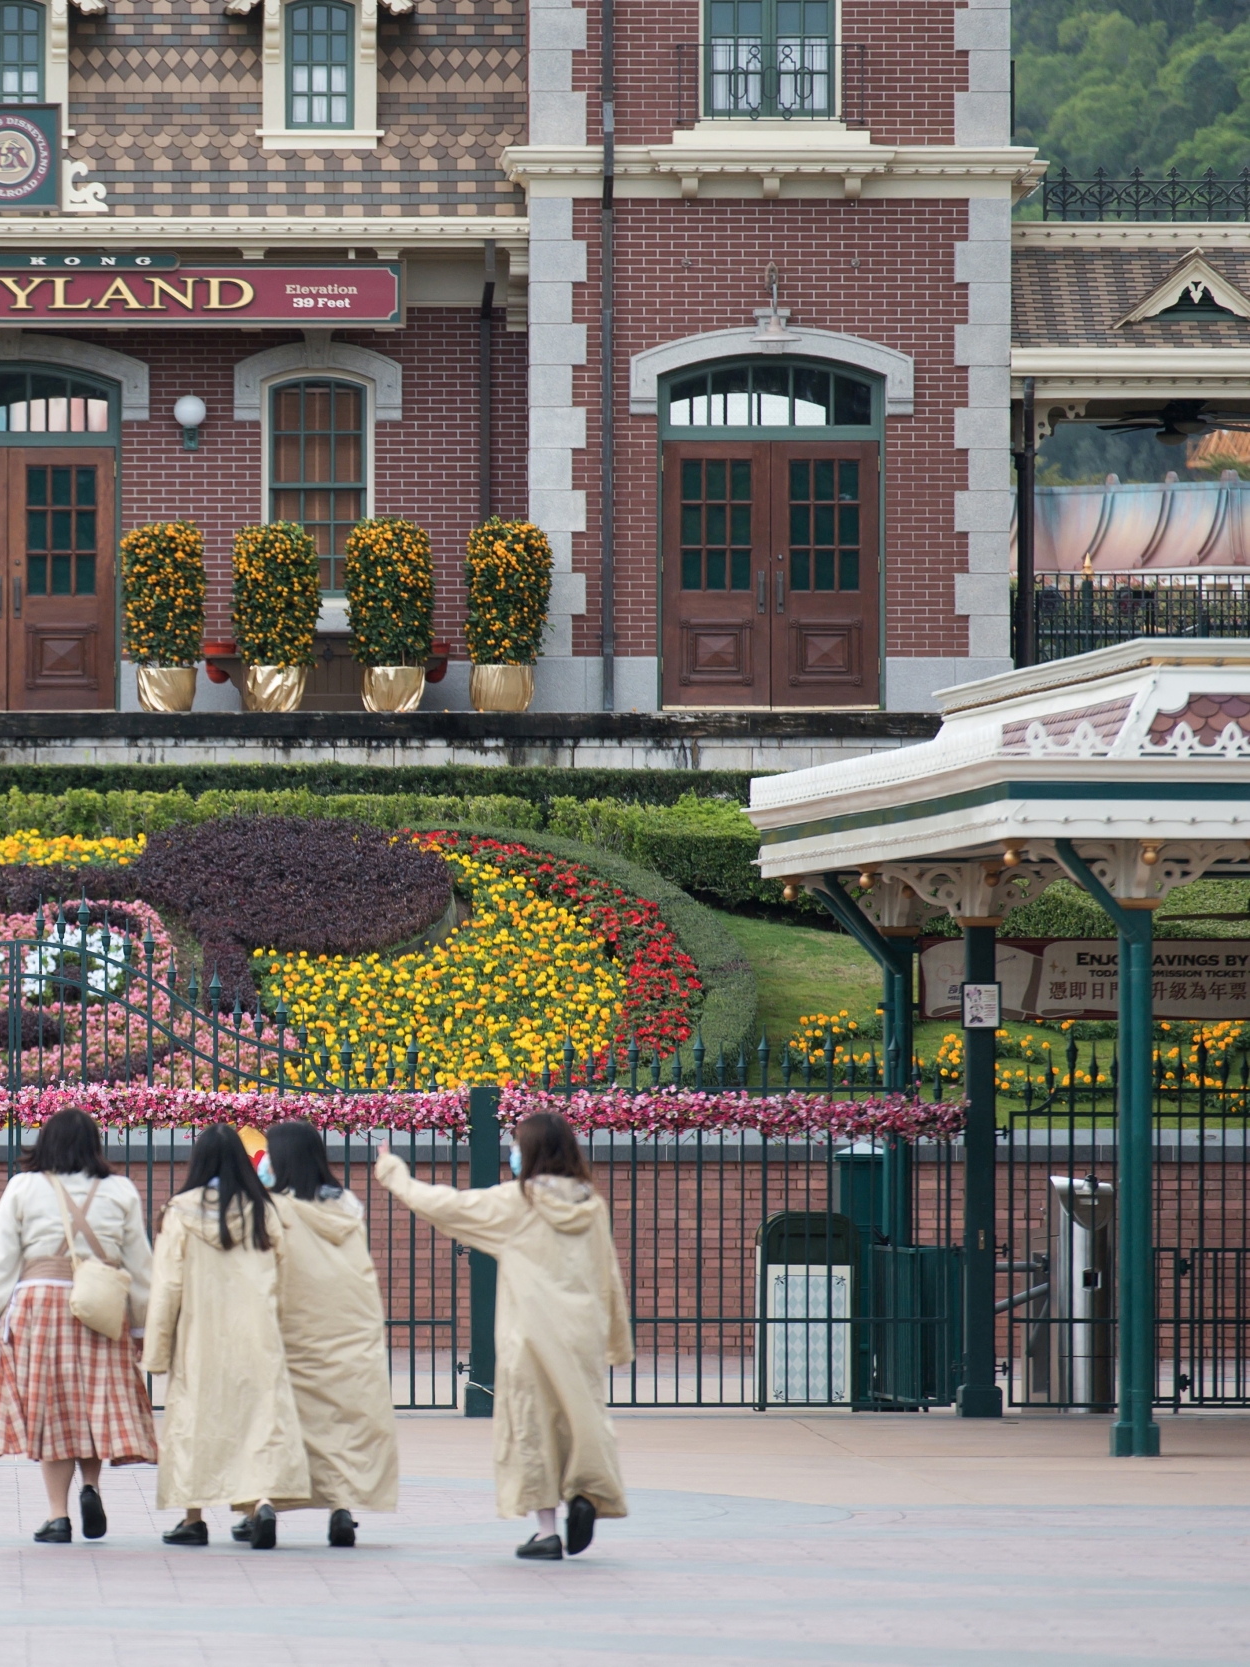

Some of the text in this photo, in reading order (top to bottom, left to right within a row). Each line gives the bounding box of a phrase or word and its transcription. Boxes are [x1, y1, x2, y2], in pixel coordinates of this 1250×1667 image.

[5, 117, 49, 175] DISNEYLAND
[29, 256, 152, 266] KONG
[285, 284, 358, 294] Elevation
[293, 297, 351, 308] 39 Feet
[1152, 954, 1220, 966] AVINGS
[1225, 954, 1249, 966] BY
[1205, 969, 1247, 978] TICKET
